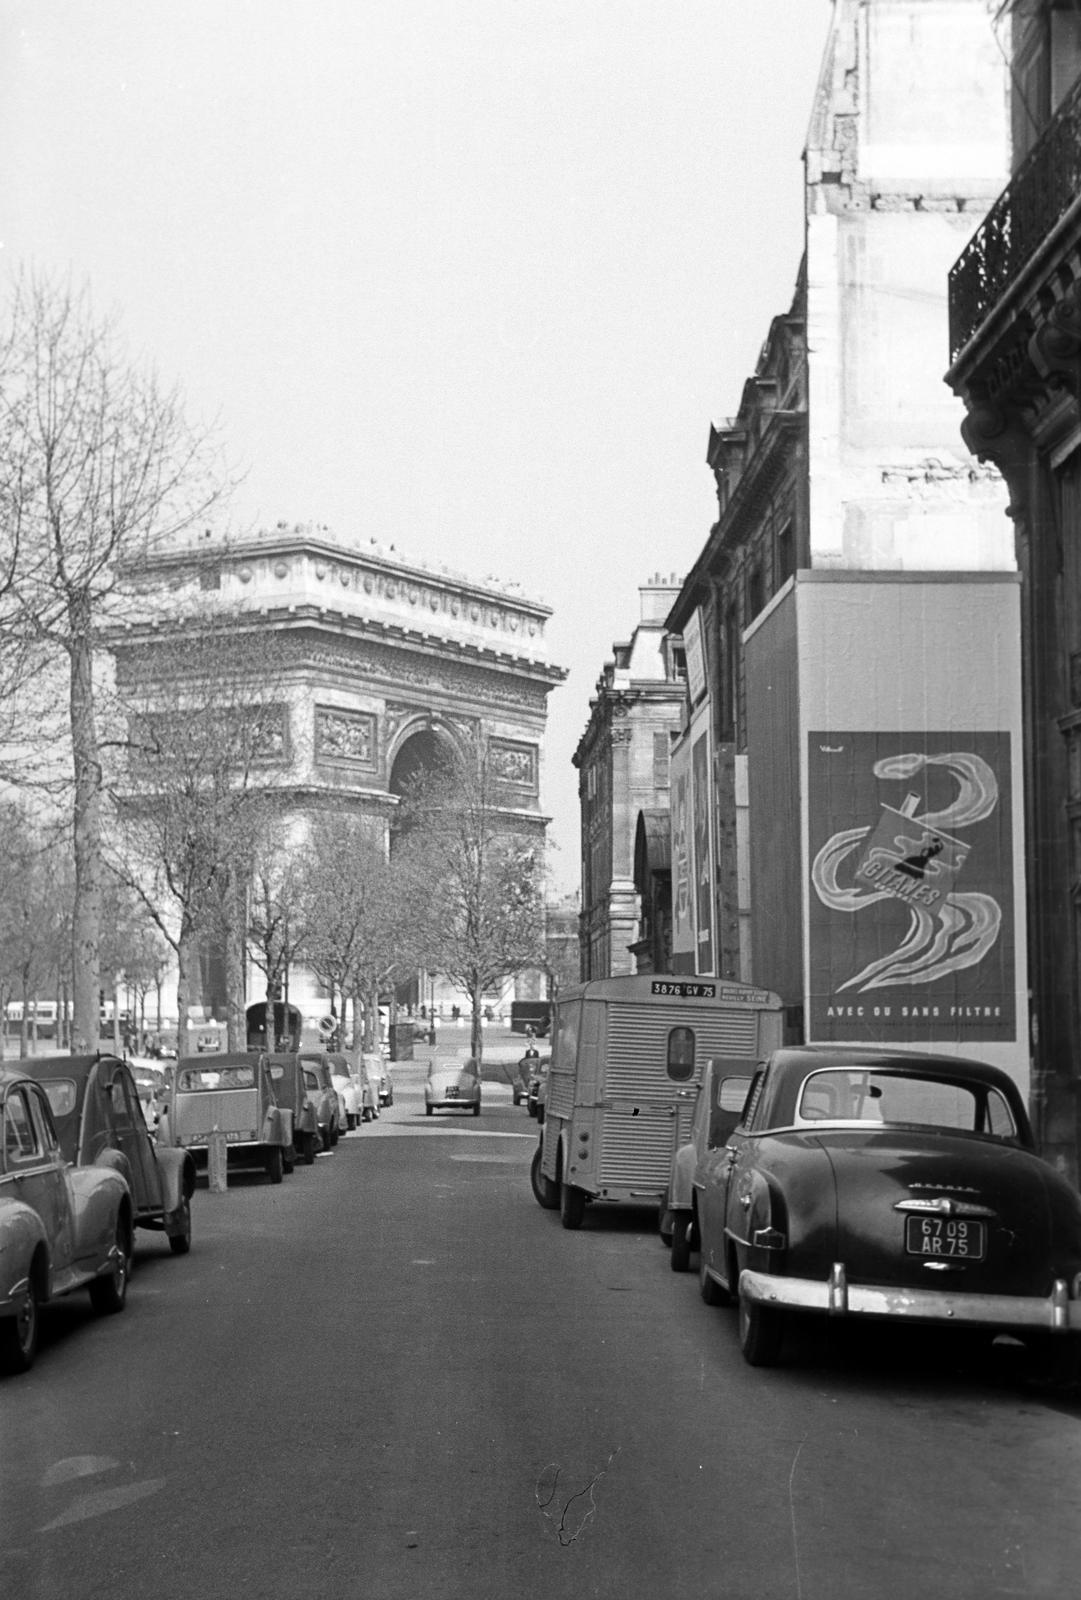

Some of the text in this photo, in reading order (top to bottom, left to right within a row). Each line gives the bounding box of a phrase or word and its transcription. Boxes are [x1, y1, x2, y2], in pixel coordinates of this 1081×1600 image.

[864, 862, 940, 906] GITANES
[654, 983, 681, 995] 3876
[686, 985, 699, 995] GV
[703, 986, 713, 997] 75
[827, 1006, 1001, 1017] AVEC OU SANS FILTRE
[922, 1236, 968, 1255] AR 75
